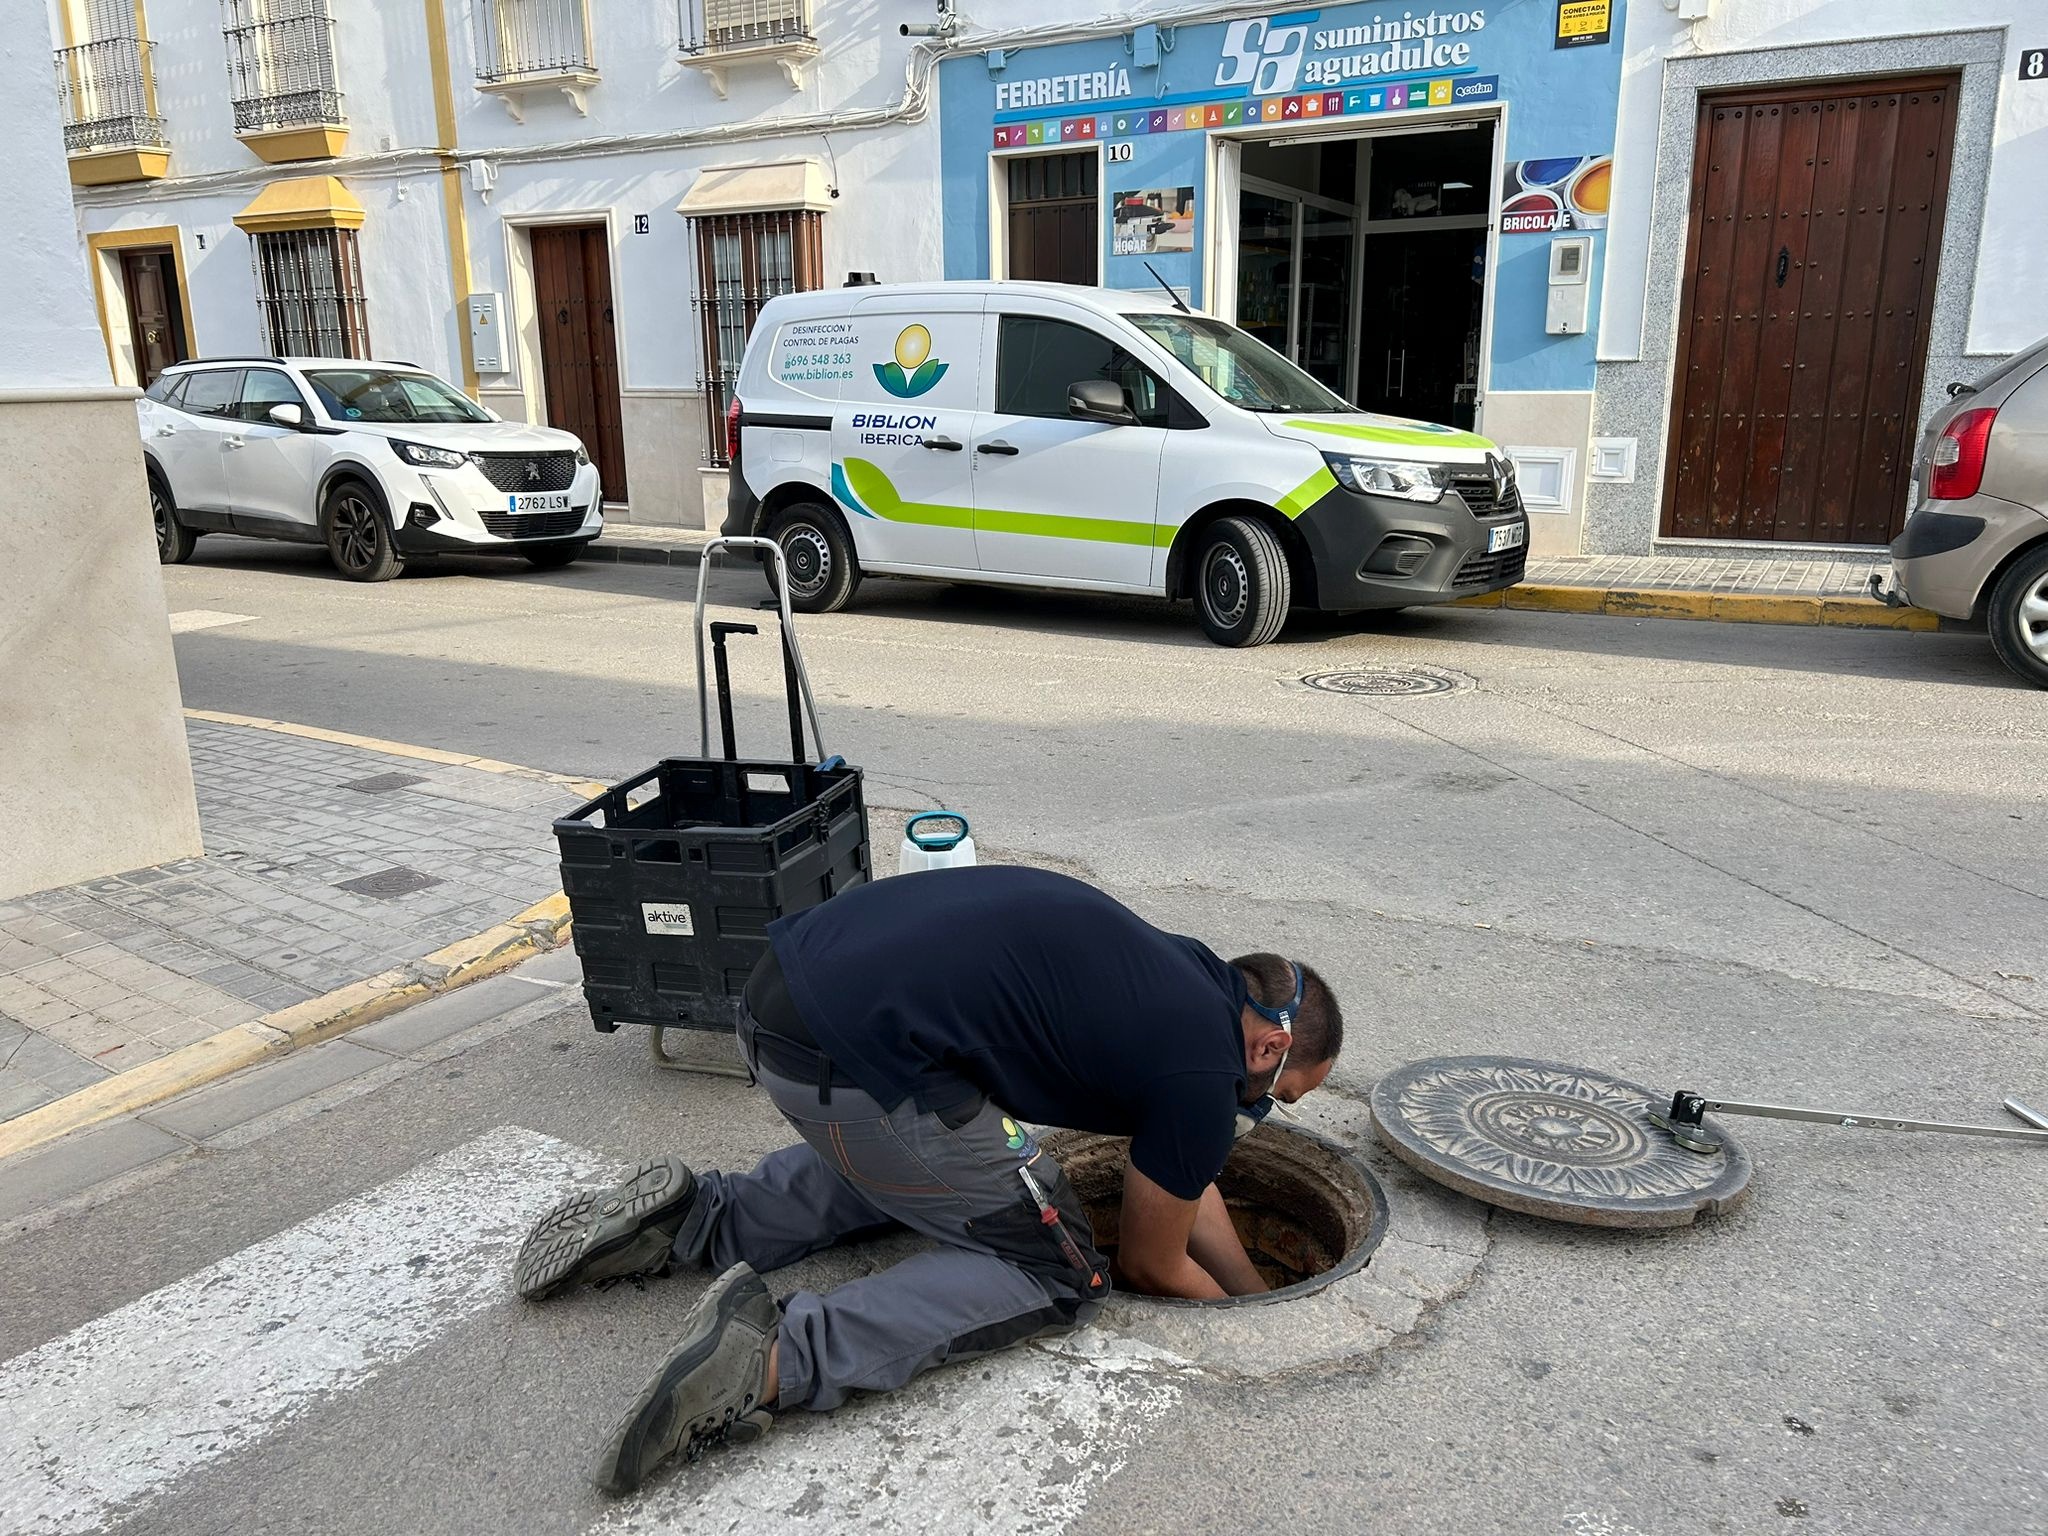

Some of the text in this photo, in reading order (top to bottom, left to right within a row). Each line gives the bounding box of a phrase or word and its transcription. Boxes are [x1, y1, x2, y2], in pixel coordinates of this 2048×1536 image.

[1563, 4, 1606, 15] CONECTADA
[1313, 9, 1486, 51] suministros
[1304, 38, 1471, 85] aguadulce
[2027, 51, 2044, 77] 8
[995, 61, 1132, 111] FERRETERÍA
[1464, 83, 1493, 95] cofan
[1109, 143, 1131, 161] 10
[635, 216, 648, 232] 12
[1503, 213, 1571, 232] BRICOLAJE
[1115, 238, 1147, 253] HOGAR
[847, 324, 853, 332] Y
[783, 335, 859, 347] CONTROL DE PLAGAS
[791, 353, 852, 367] 696 548 363
[781, 367, 854, 381] www.biblion.es
[852, 414, 937, 430] BIBLION
[860, 433, 924, 447] IBERICA
[518, 497, 546, 510] 2762
[647, 910, 687, 923] aktive
